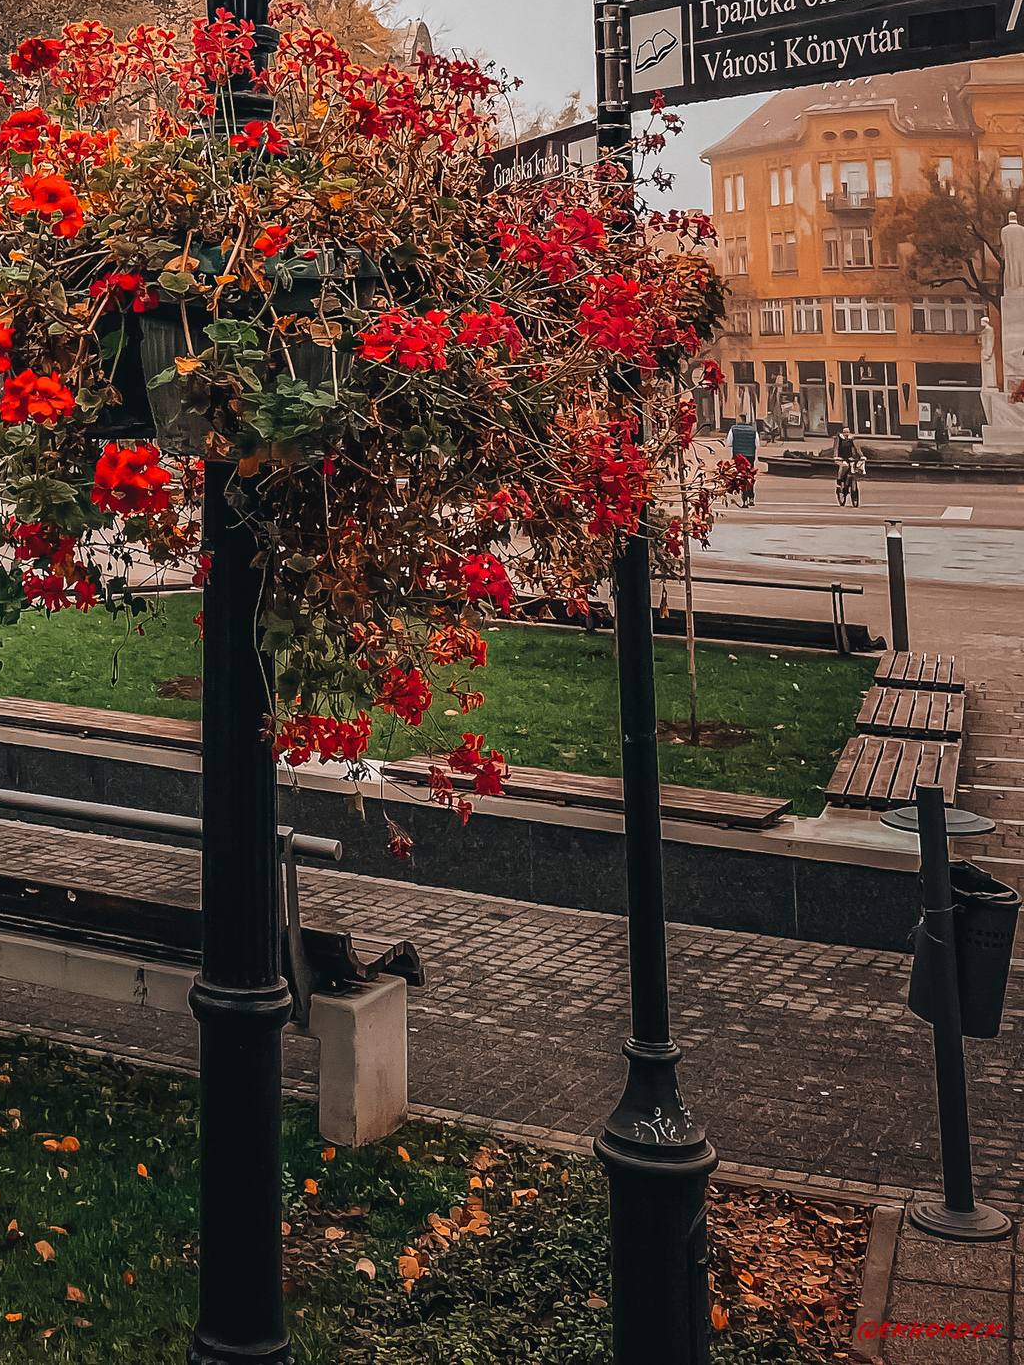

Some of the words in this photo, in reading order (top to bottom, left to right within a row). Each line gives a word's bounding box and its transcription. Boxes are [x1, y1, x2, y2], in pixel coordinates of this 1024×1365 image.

[701, 41, 777, 81] Városi
[783, 19, 905, 69] Könyvtár
[493, 155, 533, 188] Gradska
